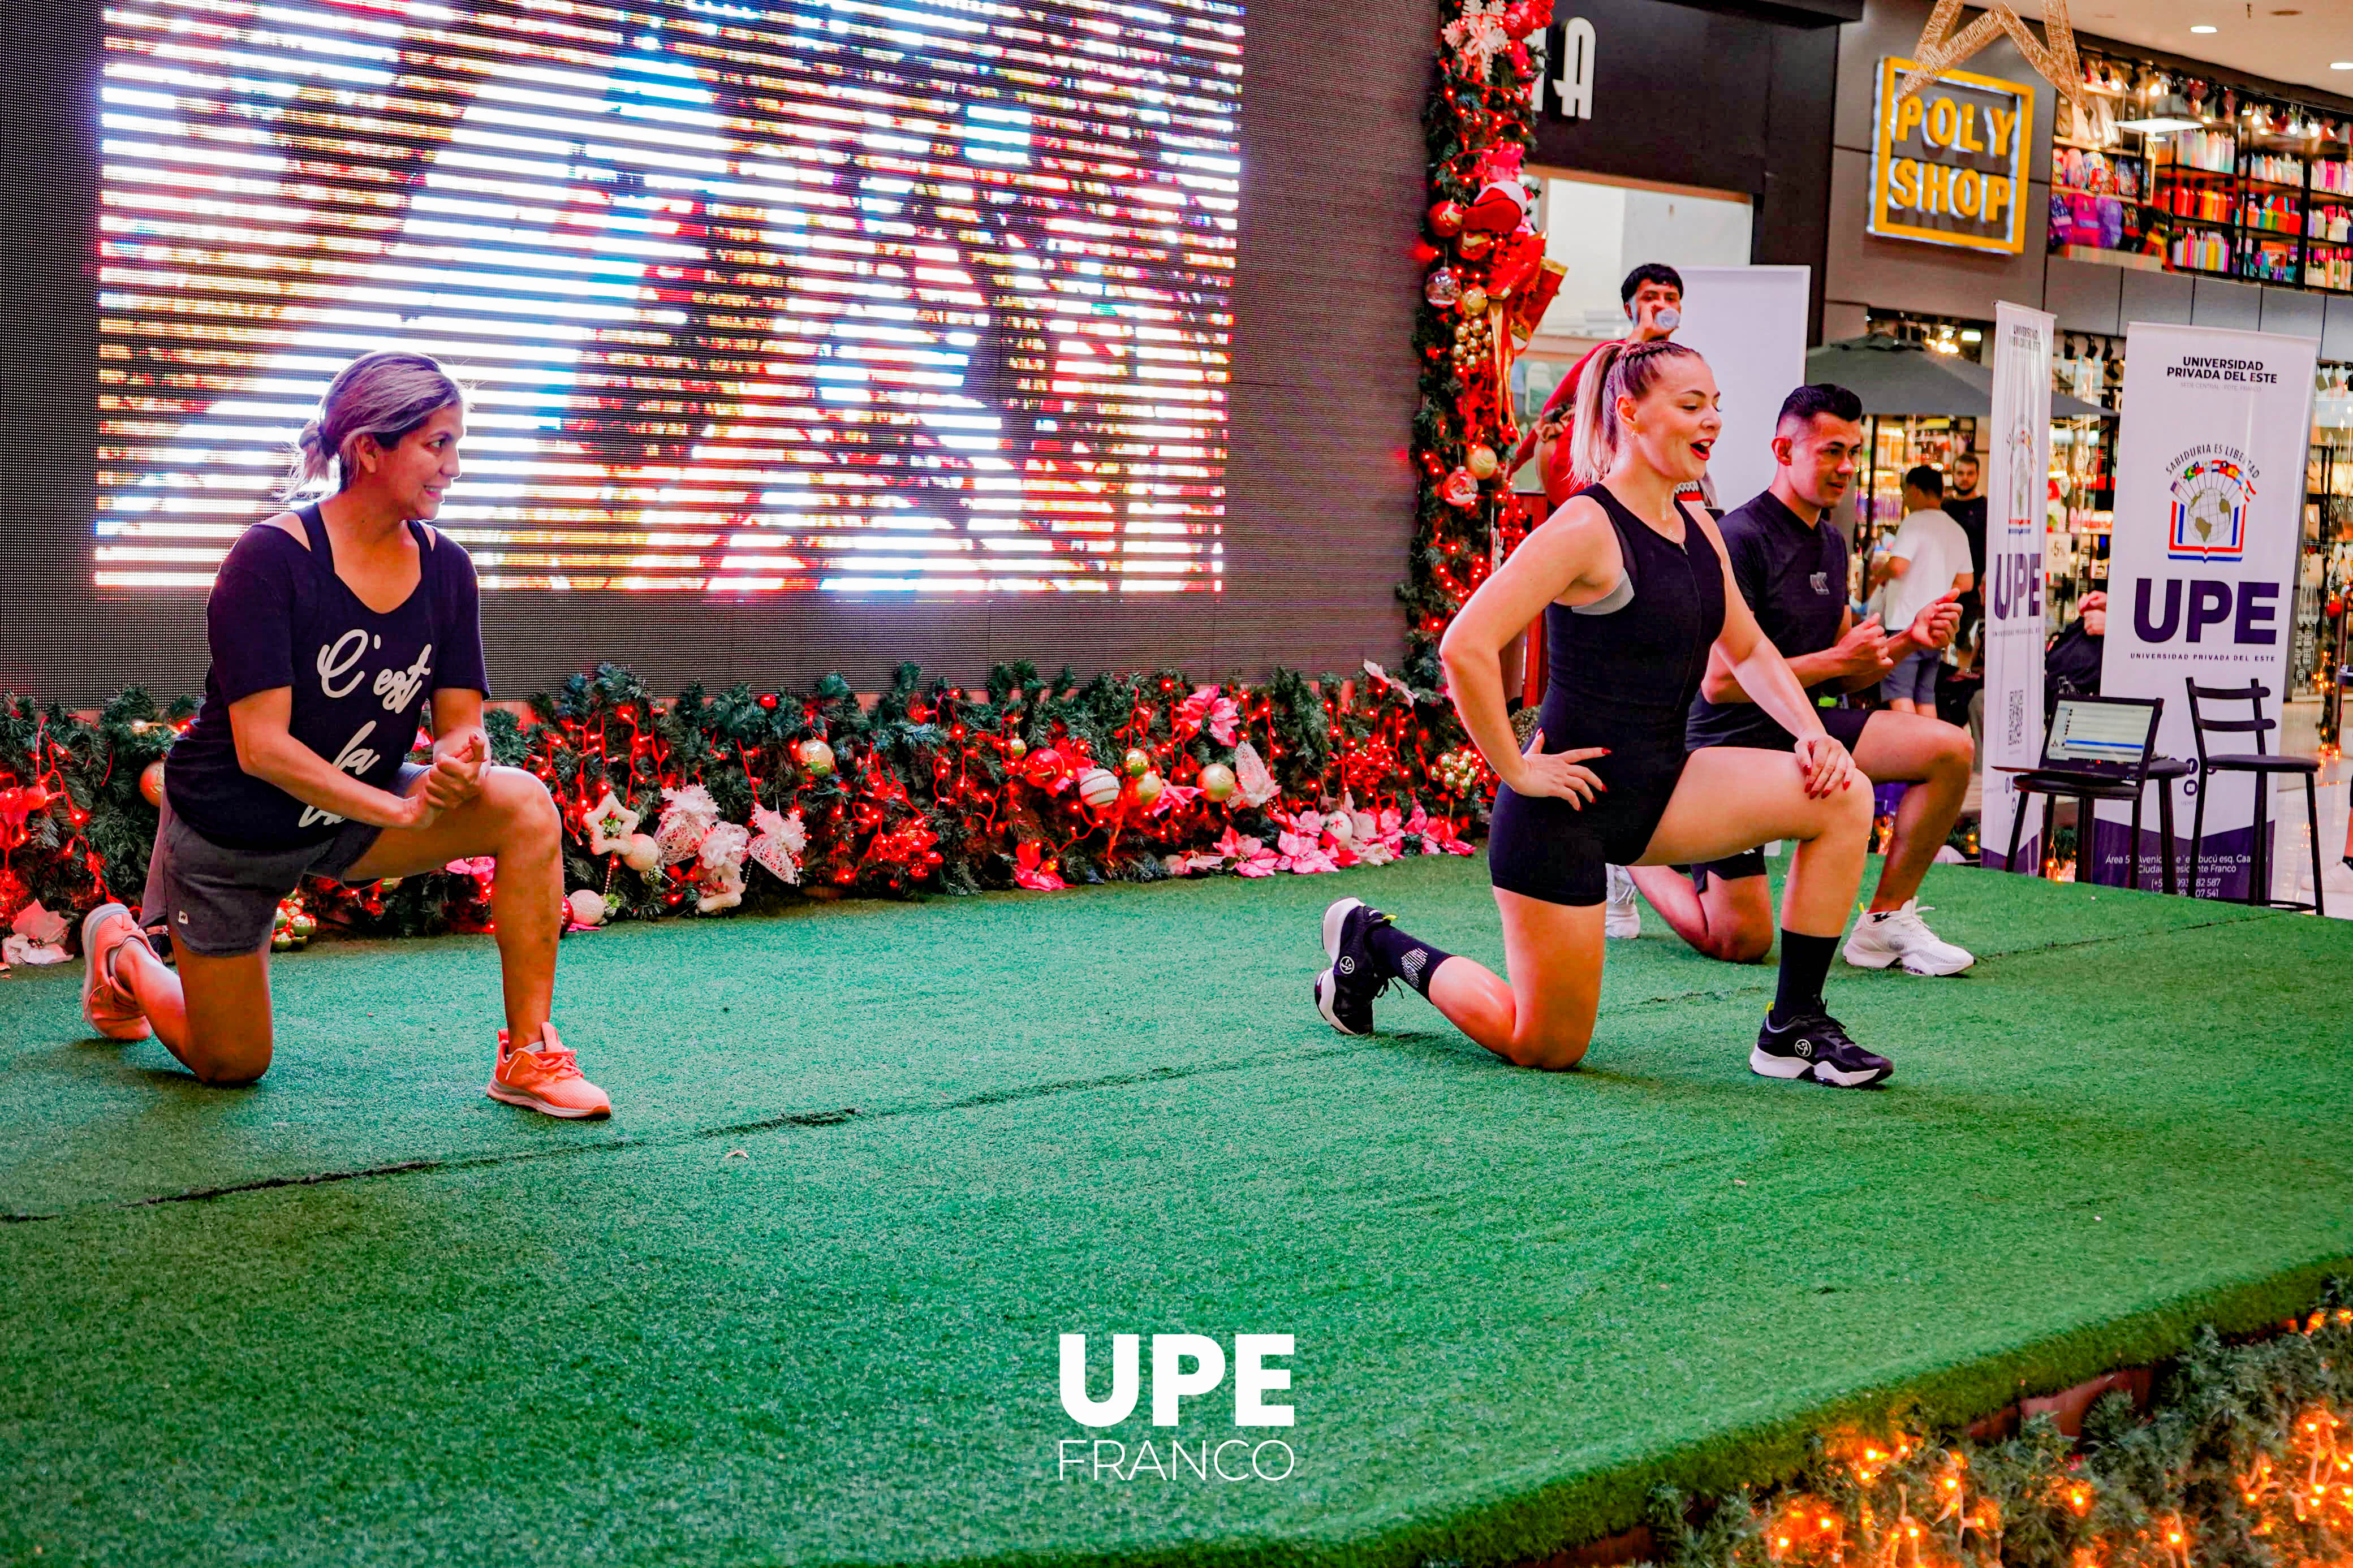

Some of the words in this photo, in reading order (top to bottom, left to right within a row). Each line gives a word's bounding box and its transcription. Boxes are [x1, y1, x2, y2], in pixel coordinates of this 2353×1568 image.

[1895, 95, 2017, 157] POLY
[1889, 159, 2010, 223] SHOP
[2183, 356, 2264, 371] UNIVERSIDAD
[2167, 366, 2221, 380] PRIVADA
[2224, 370, 2247, 382] DEL
[2250, 373, 2278, 383] ESTE
[2166, 444, 2211, 476] SABIDURIA
[2214, 444, 2223, 453] ES
[1994, 554, 2041, 620] UPE
[2134, 578, 2280, 645] UPE
[2105, 853, 2123, 864] Área
[2210, 864, 2236, 874] Franco
[2207, 878, 2221, 887] 587
[2205, 889, 2218, 898] 541
